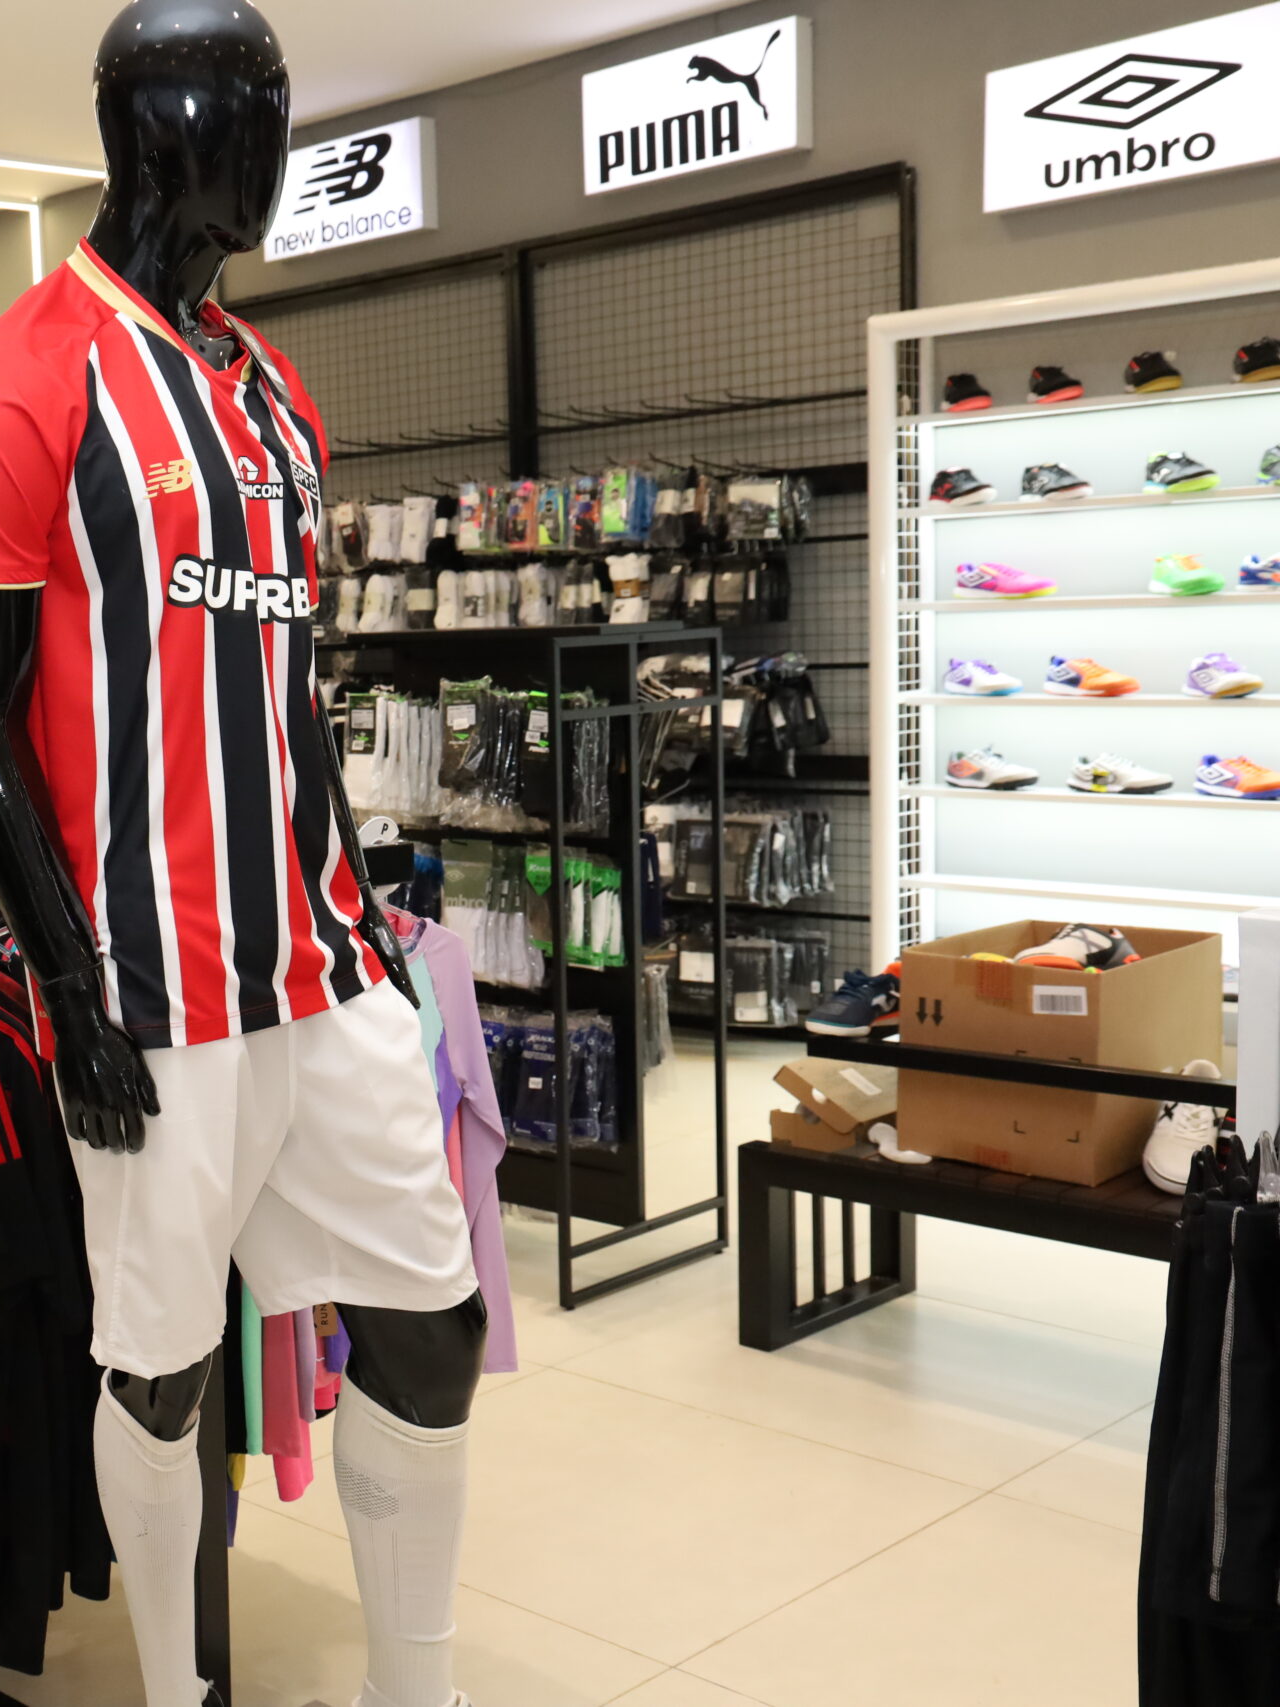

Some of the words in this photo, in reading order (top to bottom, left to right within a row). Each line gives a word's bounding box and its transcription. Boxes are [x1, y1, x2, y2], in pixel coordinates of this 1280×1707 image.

[599, 100, 740, 184] PUMA
[1044, 132, 1216, 188] umbro
[274, 228, 315, 254] new
[321, 206, 412, 243] balance
[292, 464, 317, 494] SPFC
[381, 822, 389, 835] P
[447, 894, 485, 908] mbro
